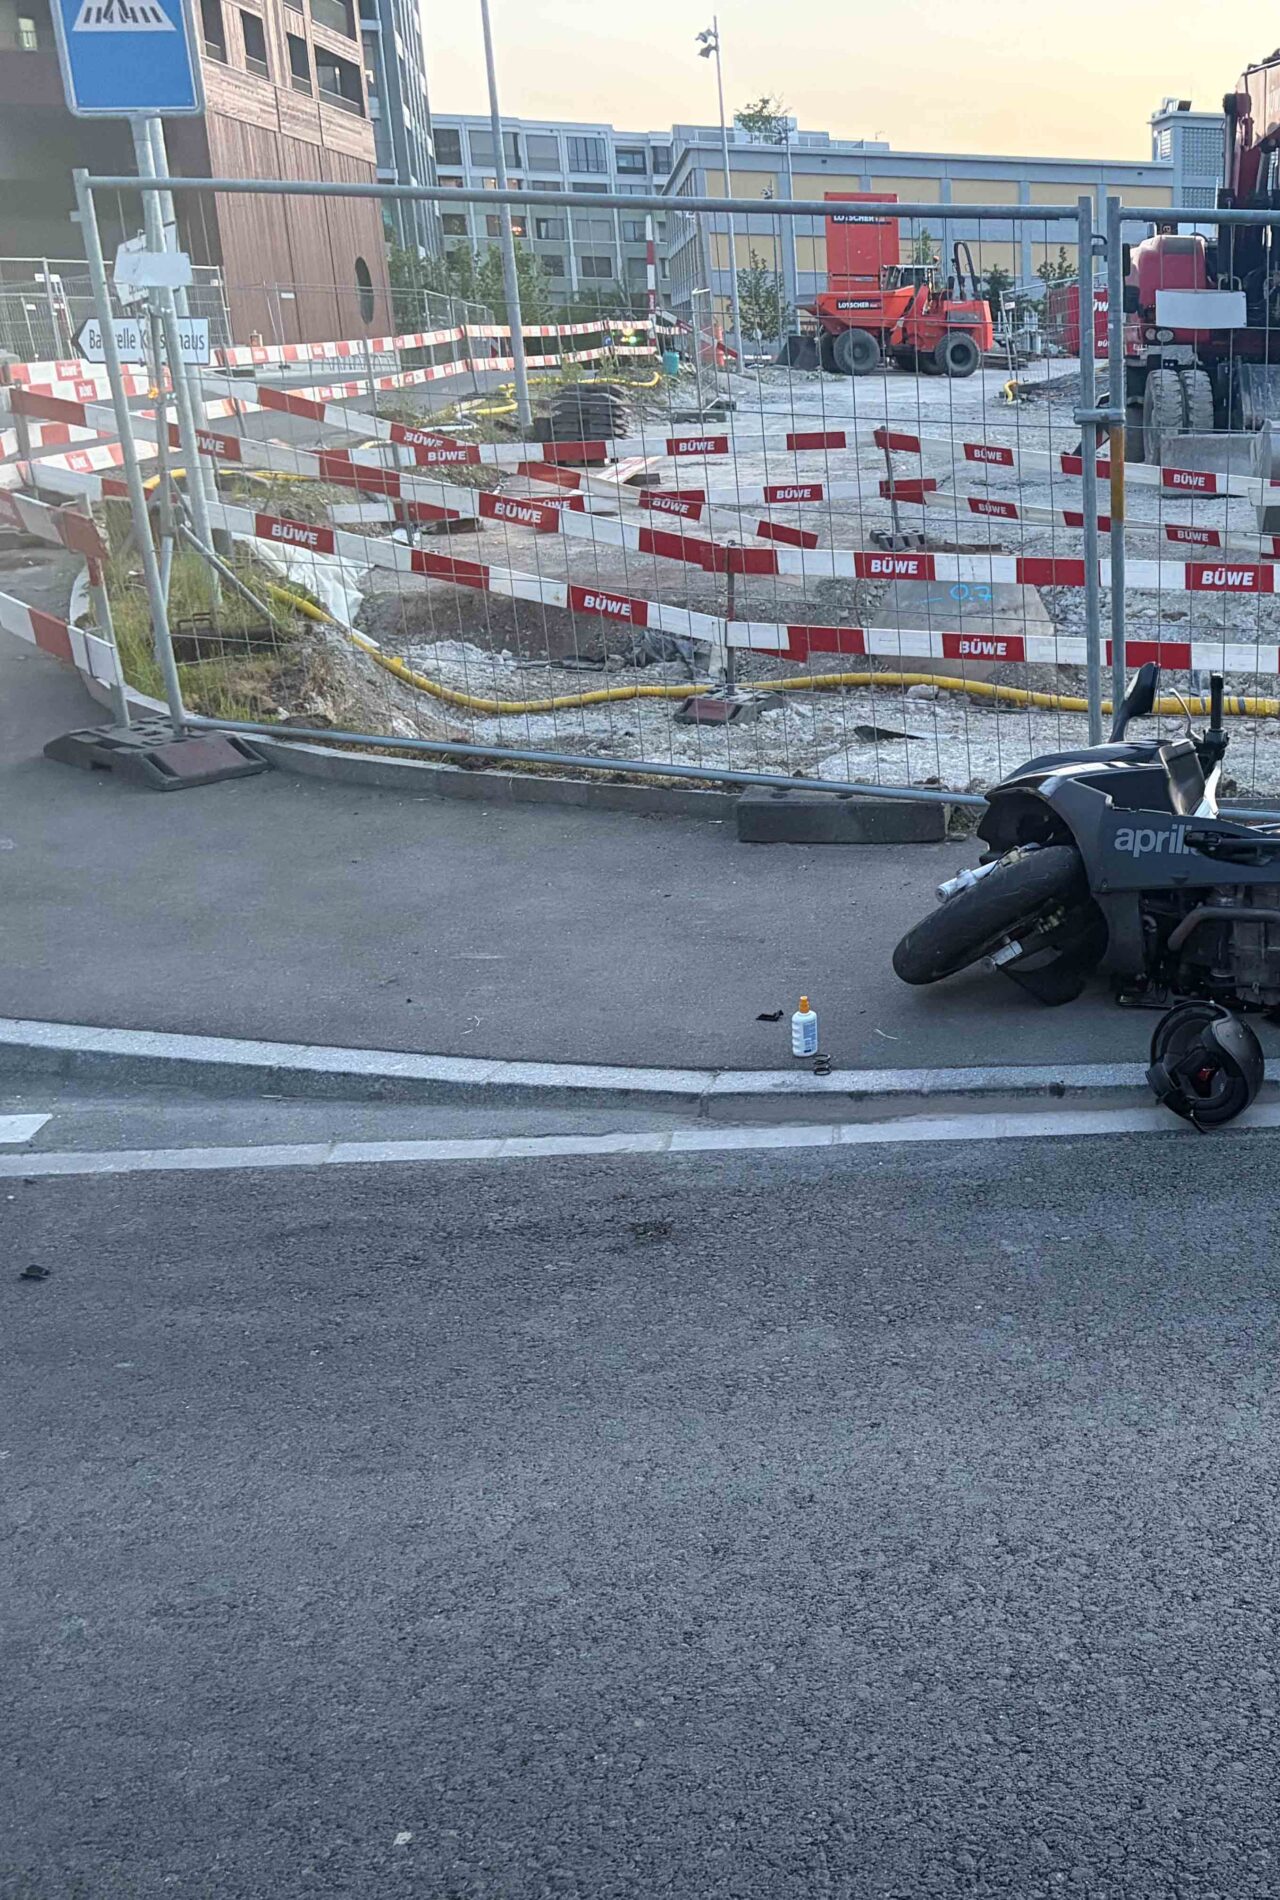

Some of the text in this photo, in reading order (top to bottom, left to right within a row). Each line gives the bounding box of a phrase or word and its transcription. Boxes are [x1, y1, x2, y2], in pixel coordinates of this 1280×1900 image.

[679, 439, 716, 452] BÜWE
[428, 448, 467, 462] BÜWE
[973, 448, 1003, 462] BÜWE
[1173, 472, 1206, 487] BÜWE
[776, 487, 812, 500] BÜWE
[494, 502, 543, 524] BÜWE
[652, 497, 690, 514] BÜWE
[978, 502, 1008, 516] BÜWE
[272, 523, 319, 546] BÜWE
[1177, 528, 1209, 543] BÜWE
[870, 556, 919, 575] BÜWE
[1201, 567, 1255, 587] BÜWE
[583, 594, 632, 617] BÜWE
[959, 638, 1008, 657] BÜWE
[1114, 824, 1200, 858] aprili
